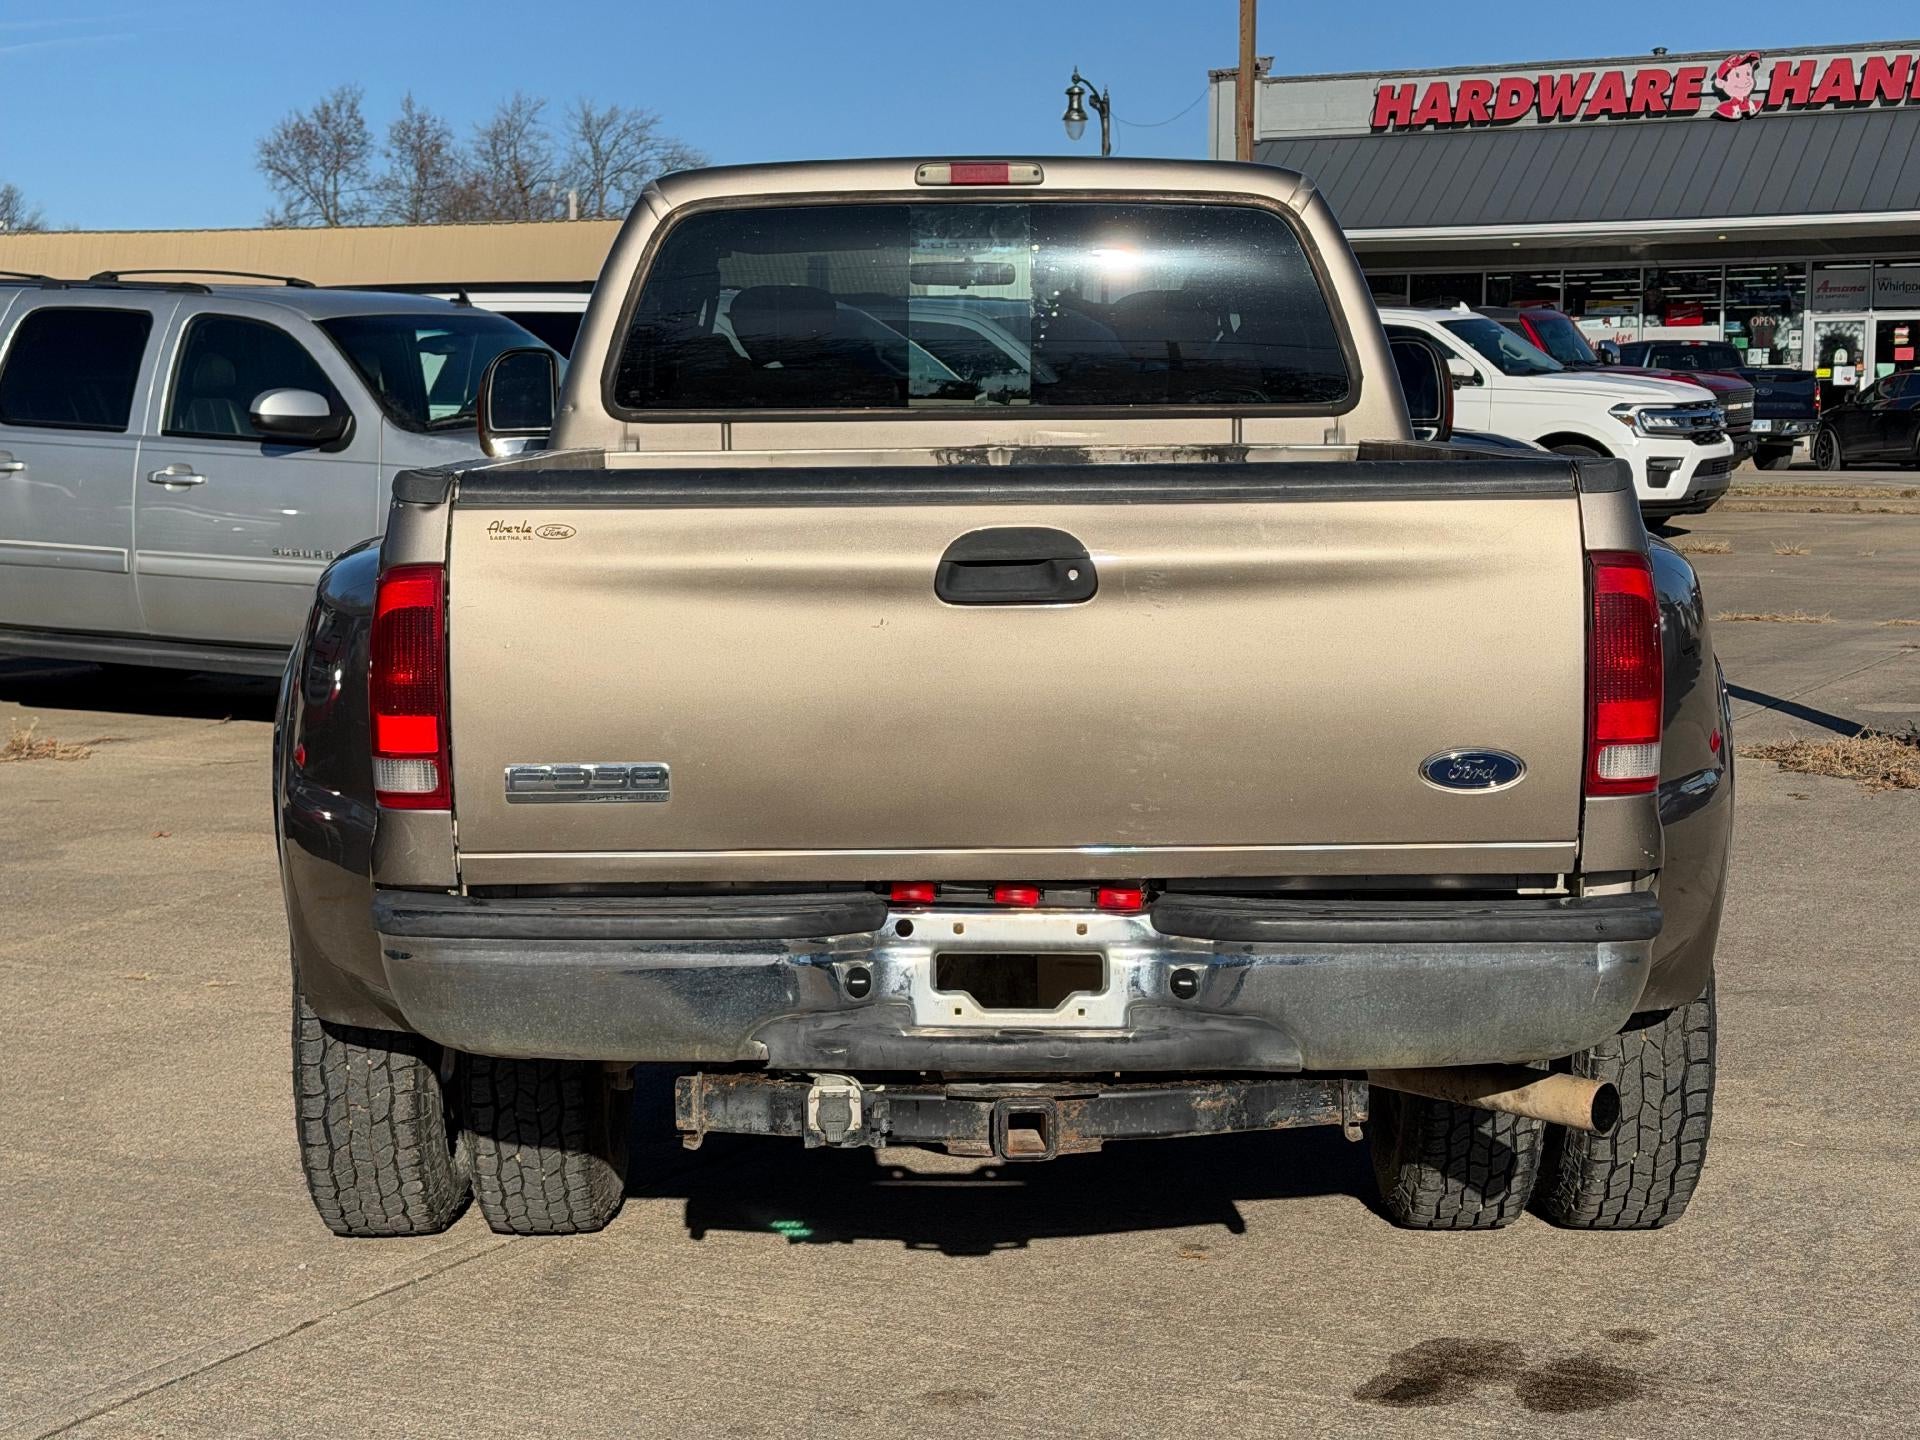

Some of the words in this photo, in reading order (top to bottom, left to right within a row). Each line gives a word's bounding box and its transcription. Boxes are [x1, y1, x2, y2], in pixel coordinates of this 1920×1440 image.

[1766, 54, 1920, 110] HAN
[1371, 66, 1708, 129] HARDWARE
[1816, 279, 1866, 293] Amana
[1877, 279, 1920, 294] Whirlpo
[1750, 315, 1776, 327] OPEN
[487, 520, 533, 534] Aberle
